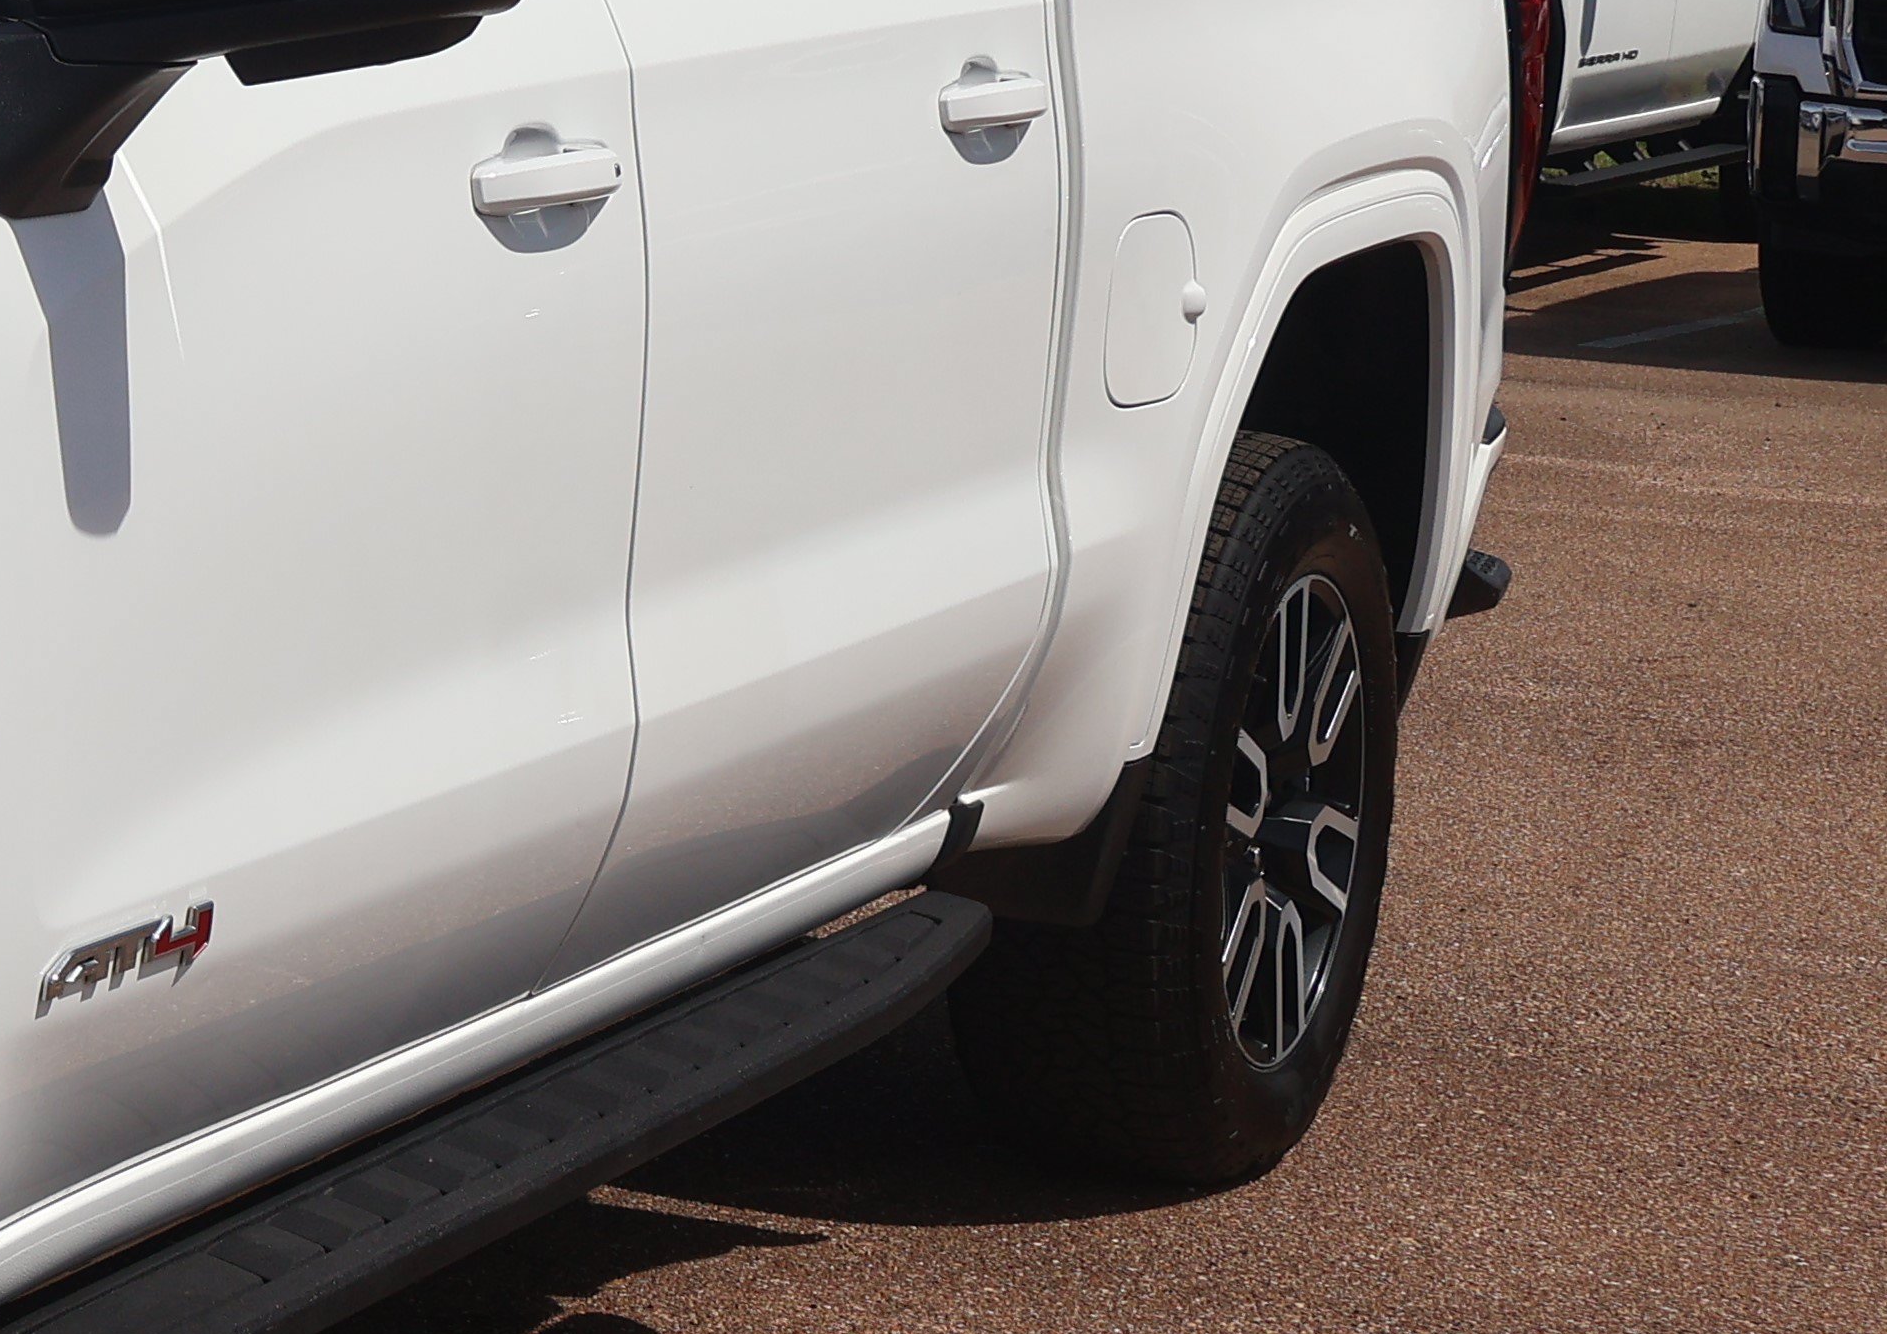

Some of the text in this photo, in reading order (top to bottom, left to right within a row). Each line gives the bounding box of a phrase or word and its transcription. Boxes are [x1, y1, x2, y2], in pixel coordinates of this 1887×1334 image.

[1578, 50, 1638, 68] SIERRA HD
[40, 899, 215, 1003] AT4
